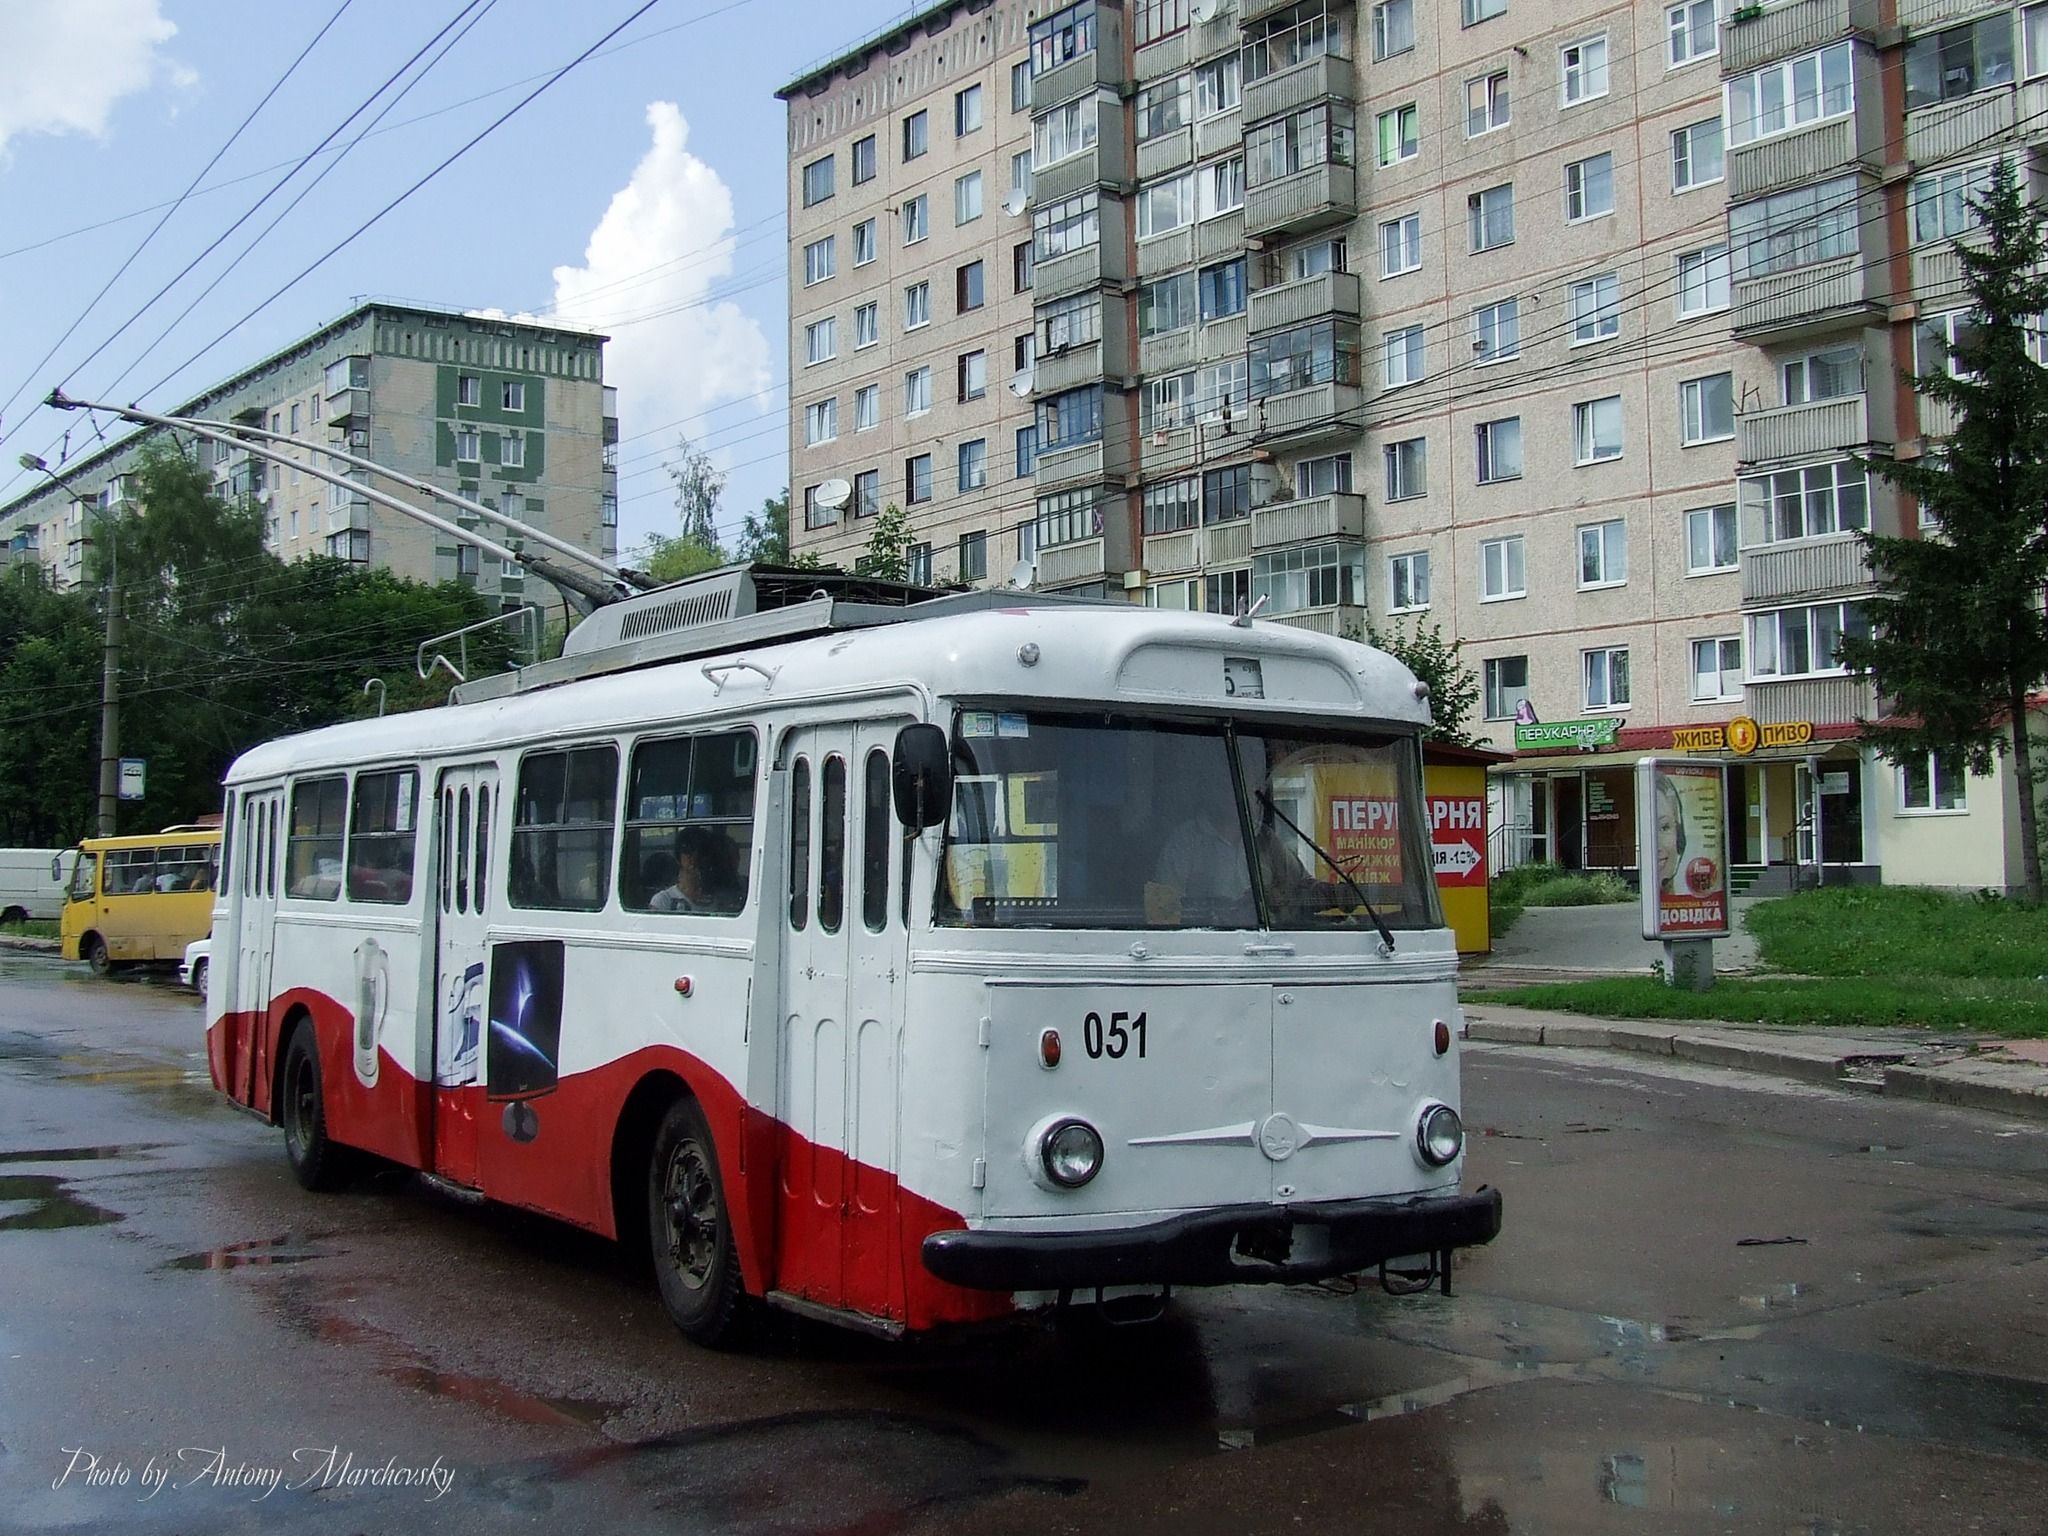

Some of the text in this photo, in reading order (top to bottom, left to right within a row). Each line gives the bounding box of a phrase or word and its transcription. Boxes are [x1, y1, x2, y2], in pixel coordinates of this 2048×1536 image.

[1675, 730, 1722, 748] ЖИВЕ
[1763, 723, 1809, 744] ПИВО
[1660, 907, 1722, 926] ДОВІДКА
[1084, 1011, 1147, 1059] 051
